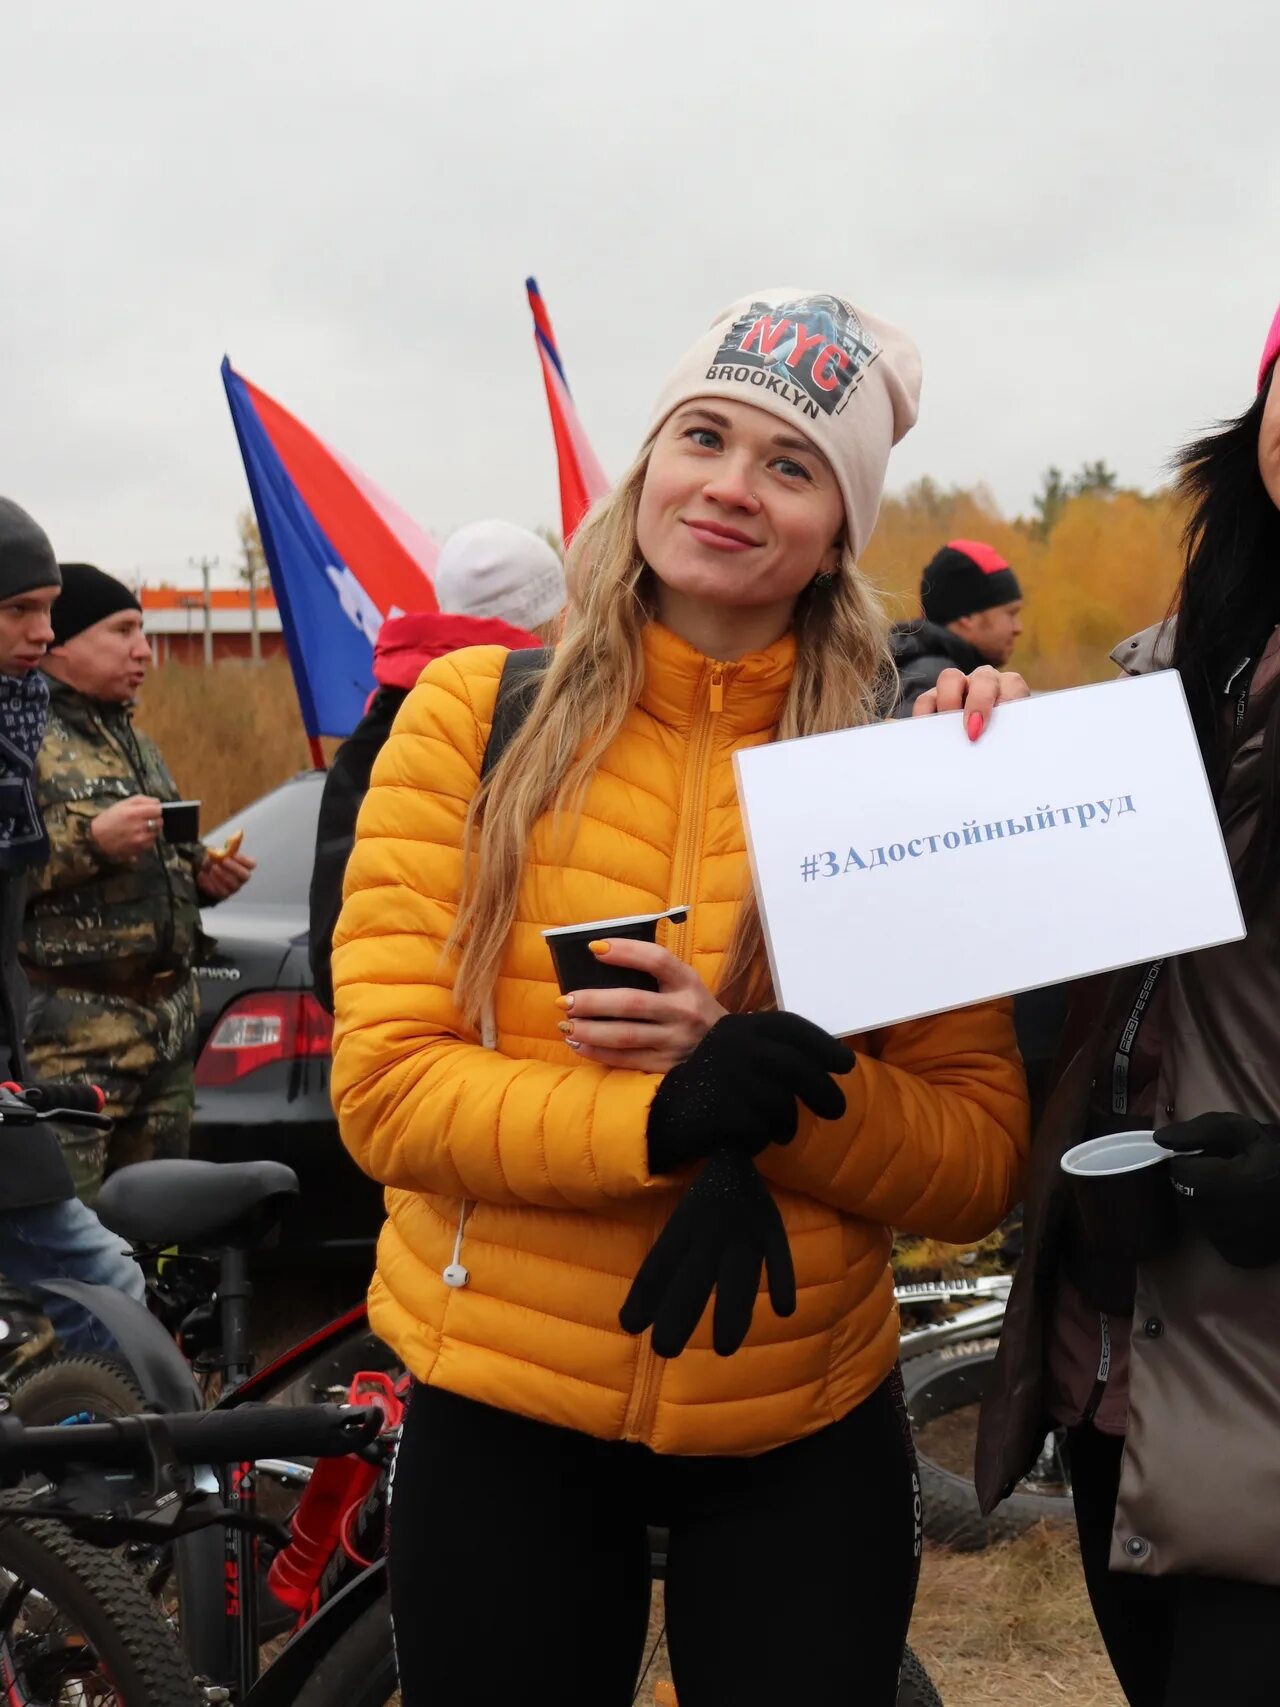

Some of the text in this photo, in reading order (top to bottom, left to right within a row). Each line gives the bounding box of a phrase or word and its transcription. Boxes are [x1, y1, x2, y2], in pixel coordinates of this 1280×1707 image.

[705, 366, 820, 420] BROOKLYN
[799, 794, 1137, 883] #ЗАдостойныйтруд
[1119, 961, 1165, 1053] PROFESSION
